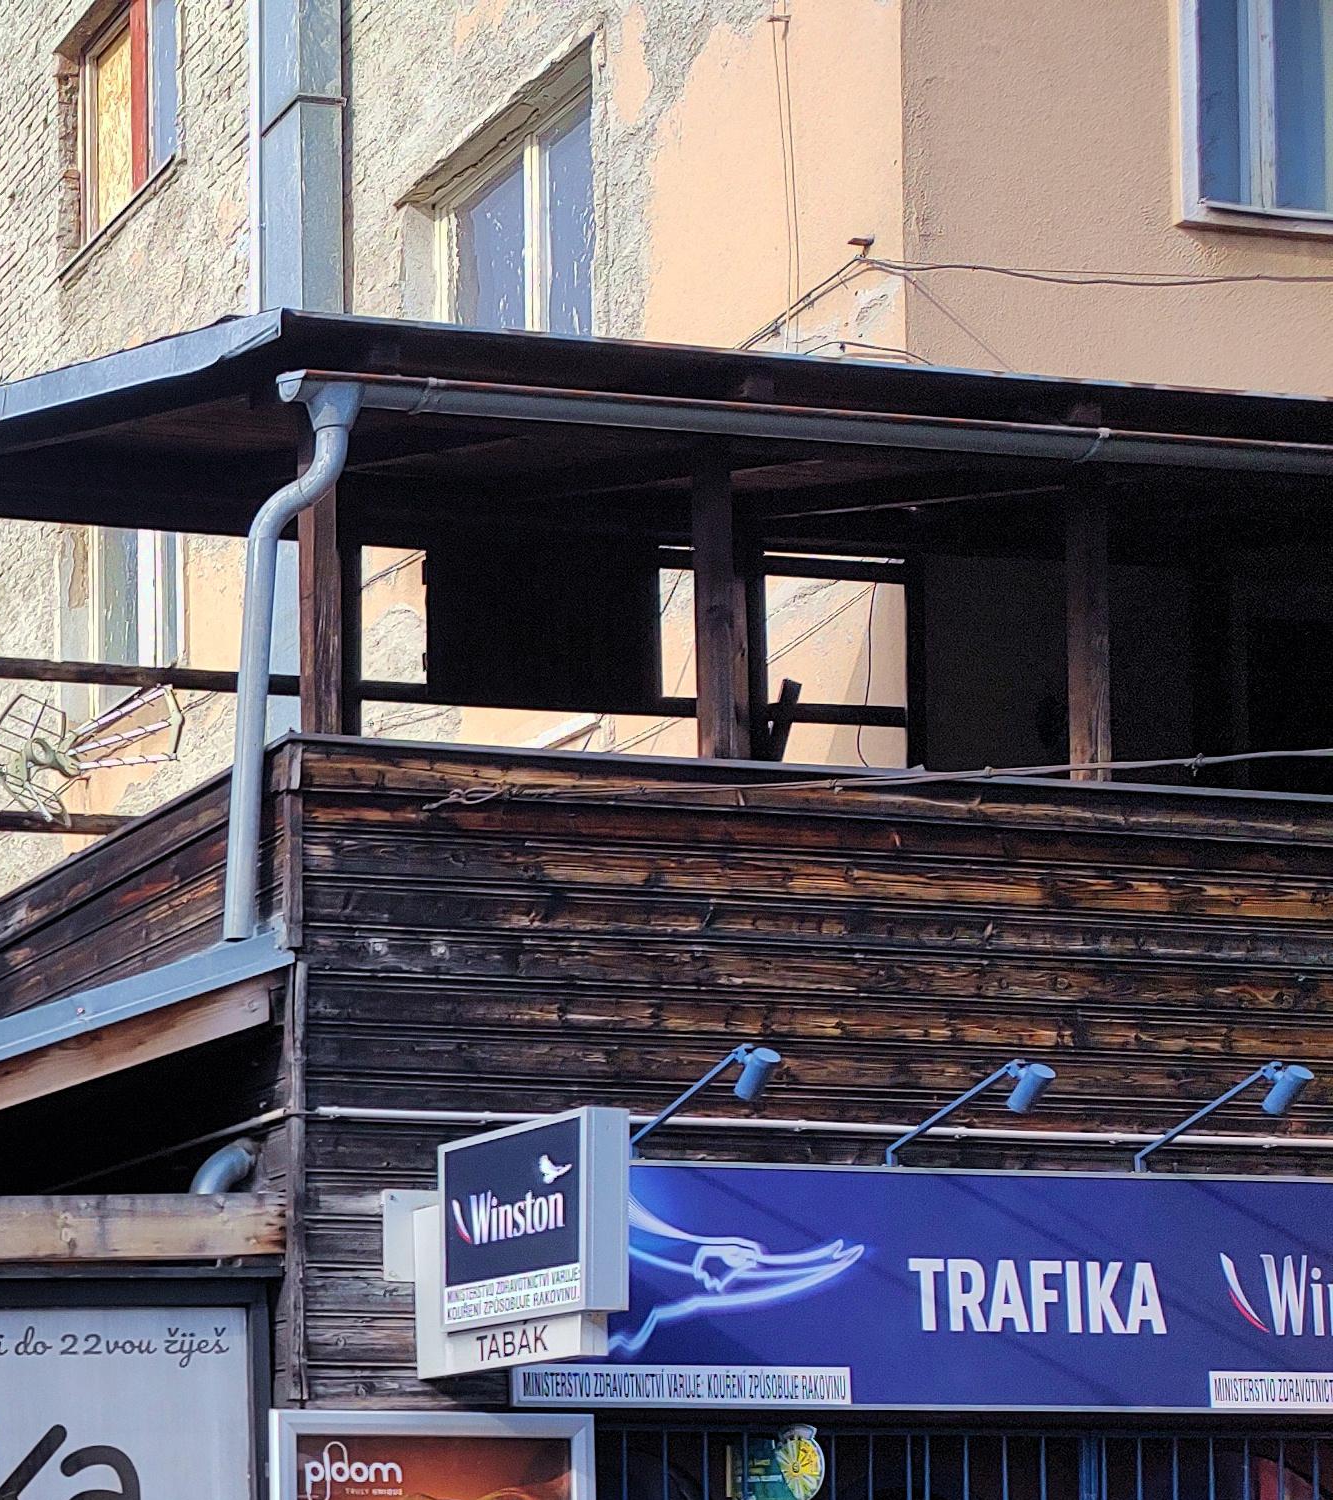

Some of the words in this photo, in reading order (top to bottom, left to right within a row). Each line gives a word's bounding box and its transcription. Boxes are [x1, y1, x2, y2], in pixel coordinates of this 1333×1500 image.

[470, 1189, 565, 1245] Winston
[908, 1258, 1167, 1334] TRAFIKA
[1259, 1254, 1333, 1336] Wi
[14, 1326, 52, 1357] do
[60, 1333, 157, 1356] 22vou
[476, 1320, 548, 1361] TABÁK
[523, 1372, 590, 1398] MINISTERSTVO
[594, 1369, 664, 1398] ZDRAVOTNICTVÍ
[707, 1370, 746, 1399] KOUŘENÍ
[749, 1369, 799, 1400] ZPŮSOBUJE
[802, 1375, 846, 1400] RAKOVINU
[1214, 1377, 1275, 1402] MINISTERSTVO
